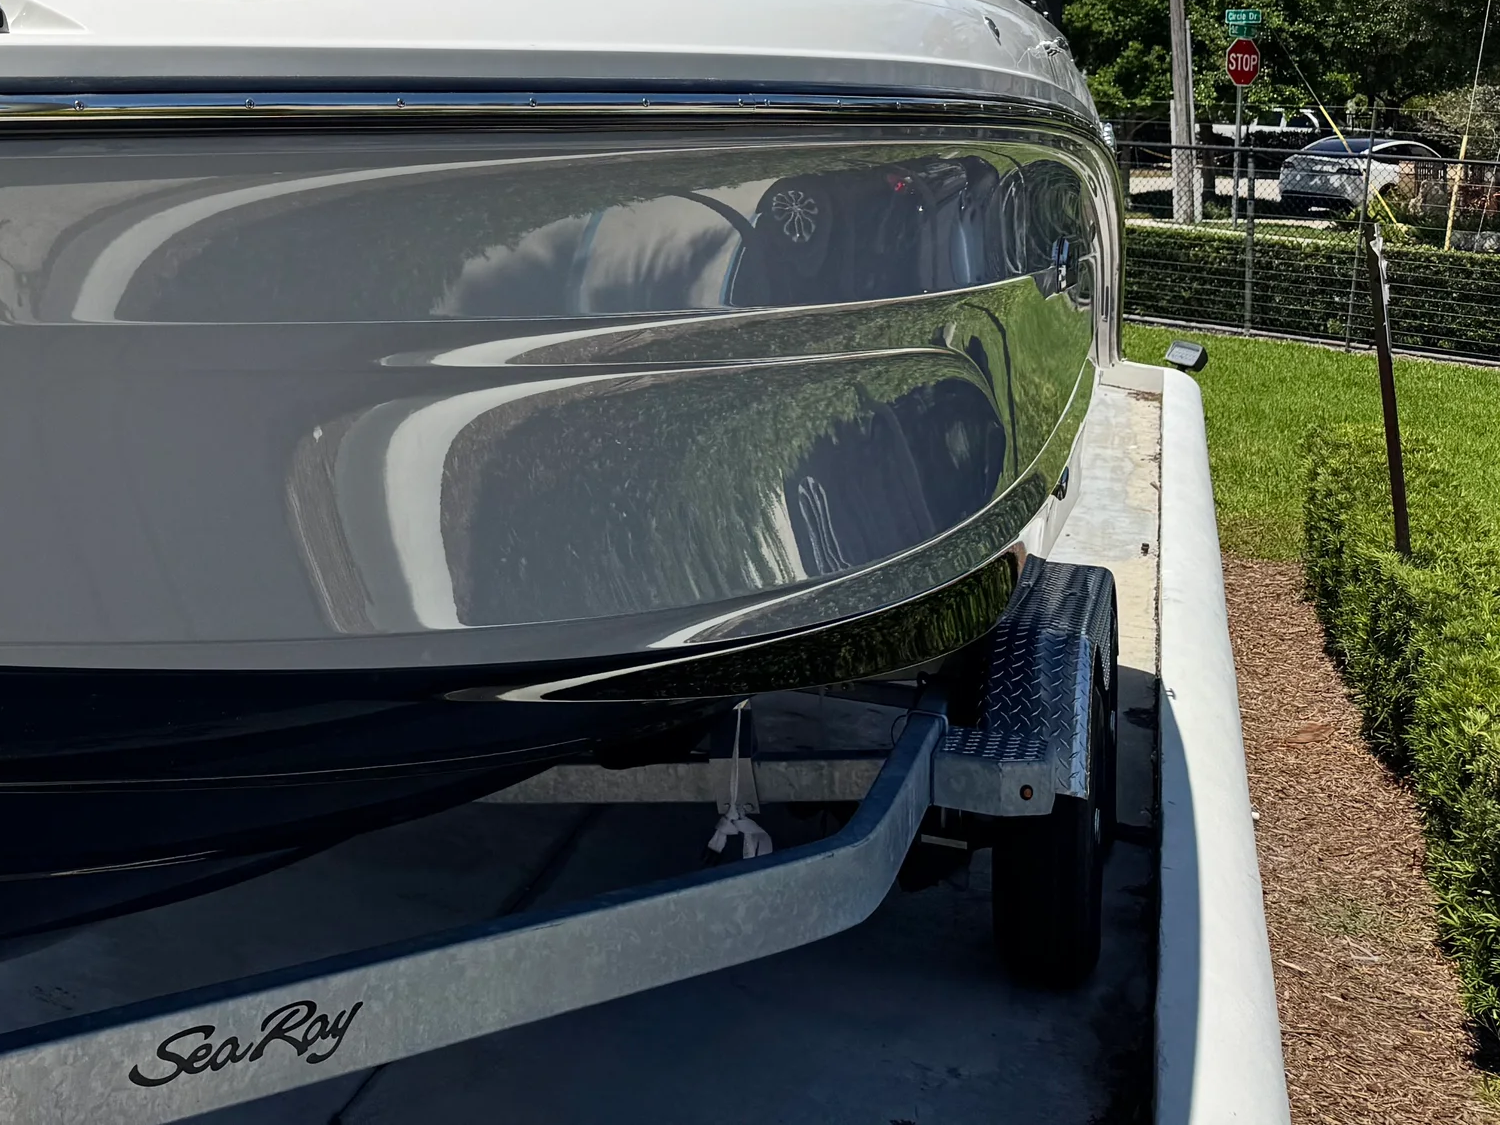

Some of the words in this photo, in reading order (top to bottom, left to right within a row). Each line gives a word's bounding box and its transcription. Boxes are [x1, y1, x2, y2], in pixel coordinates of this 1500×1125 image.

[1228, 12, 1247, 21] Circle
[1248, 12, 1258, 21] Dr
[1228, 52, 1258, 72] STOP
[128, 1024, 252, 1088] Sea
[249, 1000, 364, 1065] Ray
